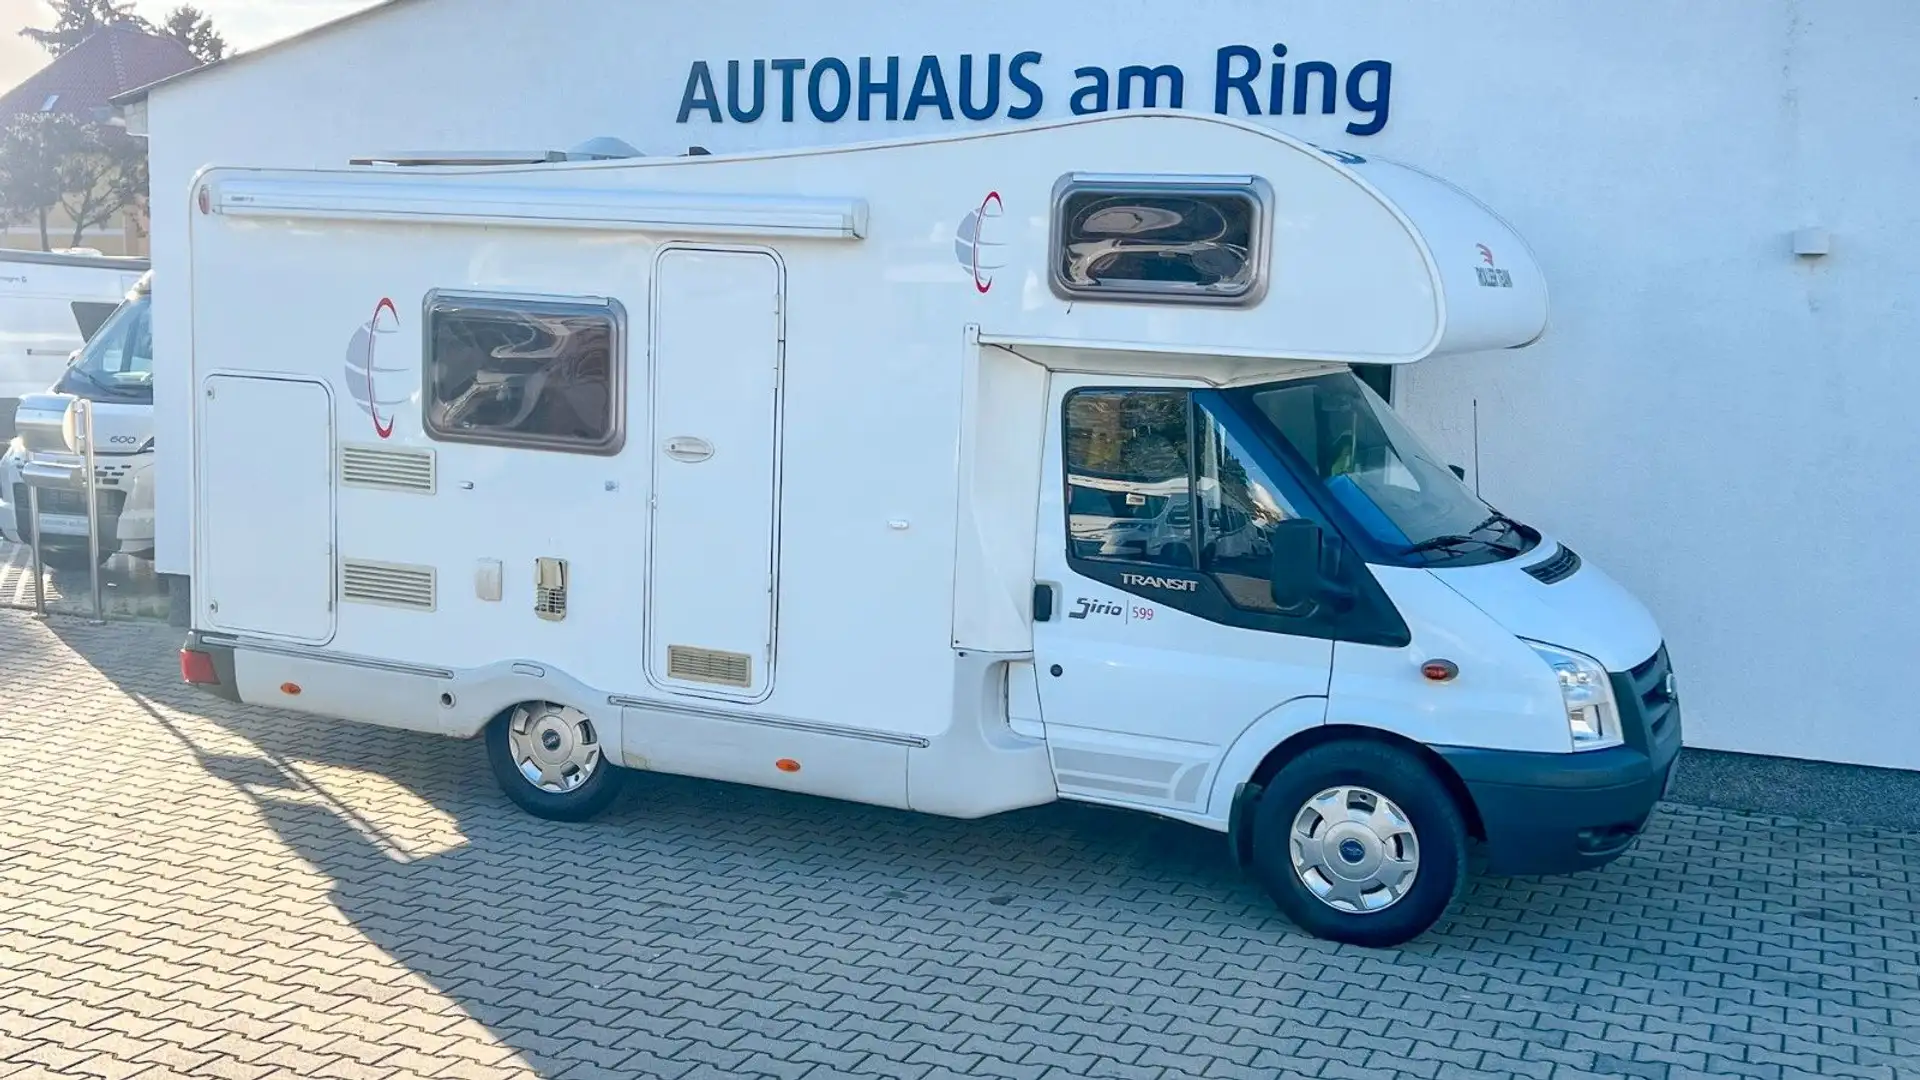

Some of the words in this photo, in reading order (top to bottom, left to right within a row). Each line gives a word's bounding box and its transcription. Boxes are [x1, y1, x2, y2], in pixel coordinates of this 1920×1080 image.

[676, 51, 1043, 123] AUTOHAUS
[1070, 64, 1183, 115] am
[1214, 43, 1392, 136] Ring
[1120, 573, 1199, 592] TRANSIT
[1068, 597, 1123, 620] Sirio
[1132, 606, 1154, 621] 599
